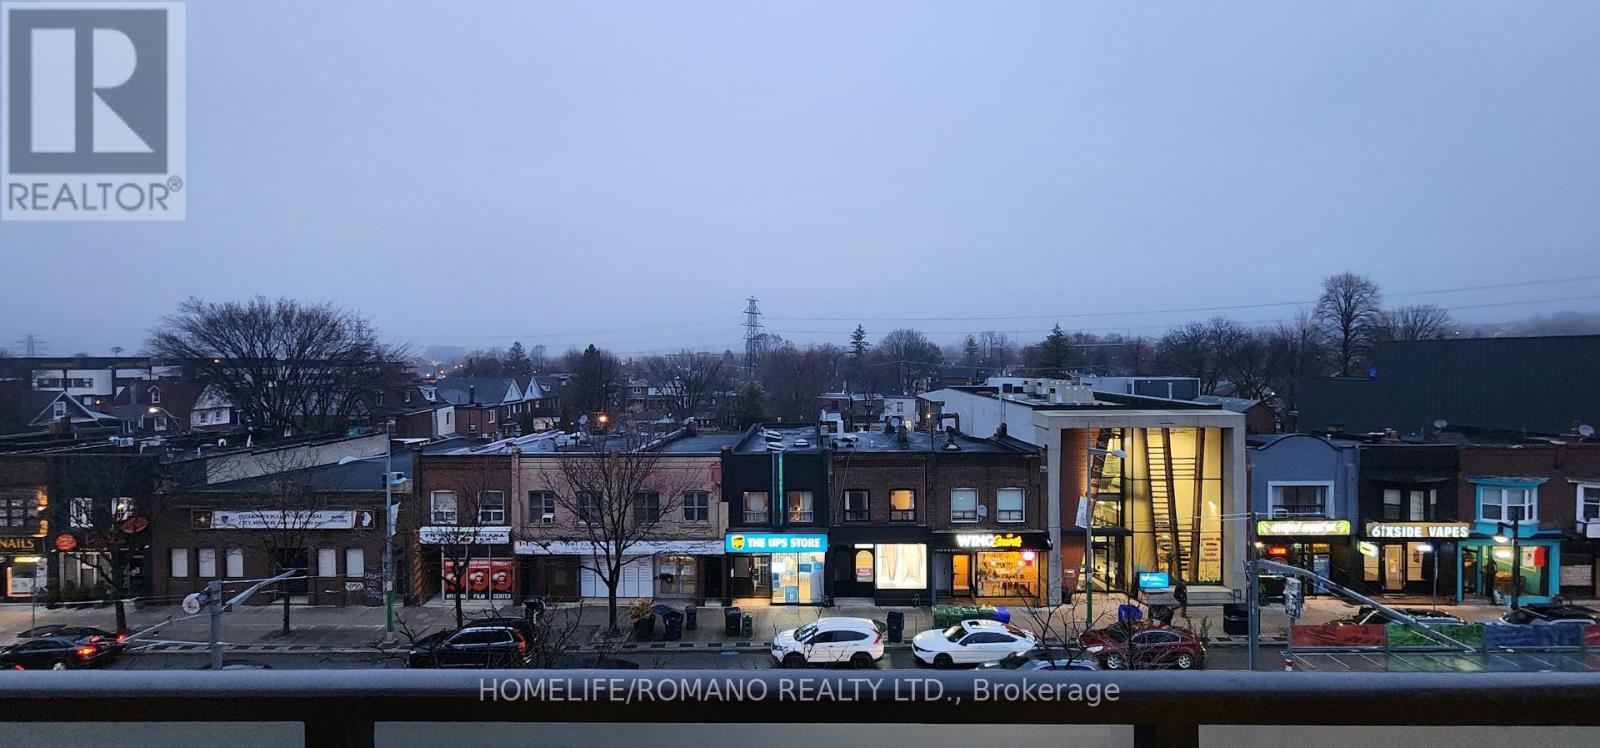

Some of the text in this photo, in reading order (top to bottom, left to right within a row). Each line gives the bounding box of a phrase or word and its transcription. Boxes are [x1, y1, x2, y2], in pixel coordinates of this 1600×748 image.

[1427, 526, 1468, 537] VAPES
[0, 538, 34, 549] NAILS
[747, 537, 820, 548] THE UPS STORE
